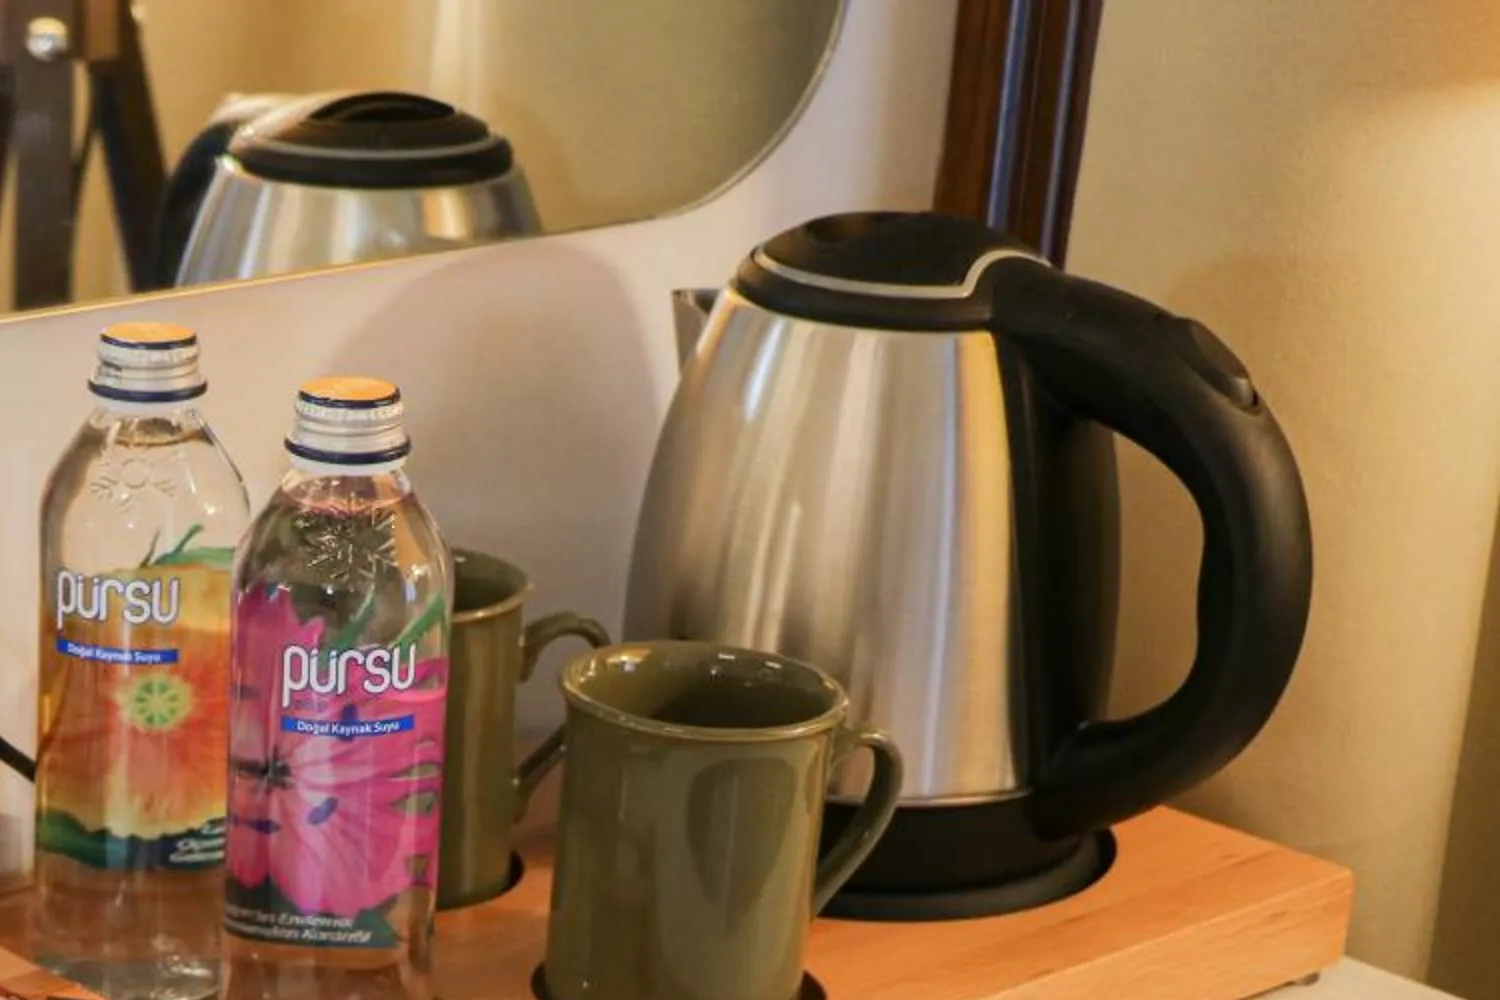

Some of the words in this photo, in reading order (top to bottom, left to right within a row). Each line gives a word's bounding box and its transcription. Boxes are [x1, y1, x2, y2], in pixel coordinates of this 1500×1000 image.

[57, 570, 179, 630] pürsu
[282, 644, 416, 708] pürsu
[331, 723, 372, 737] Kaynak
[374, 720, 400, 733] Suyu
